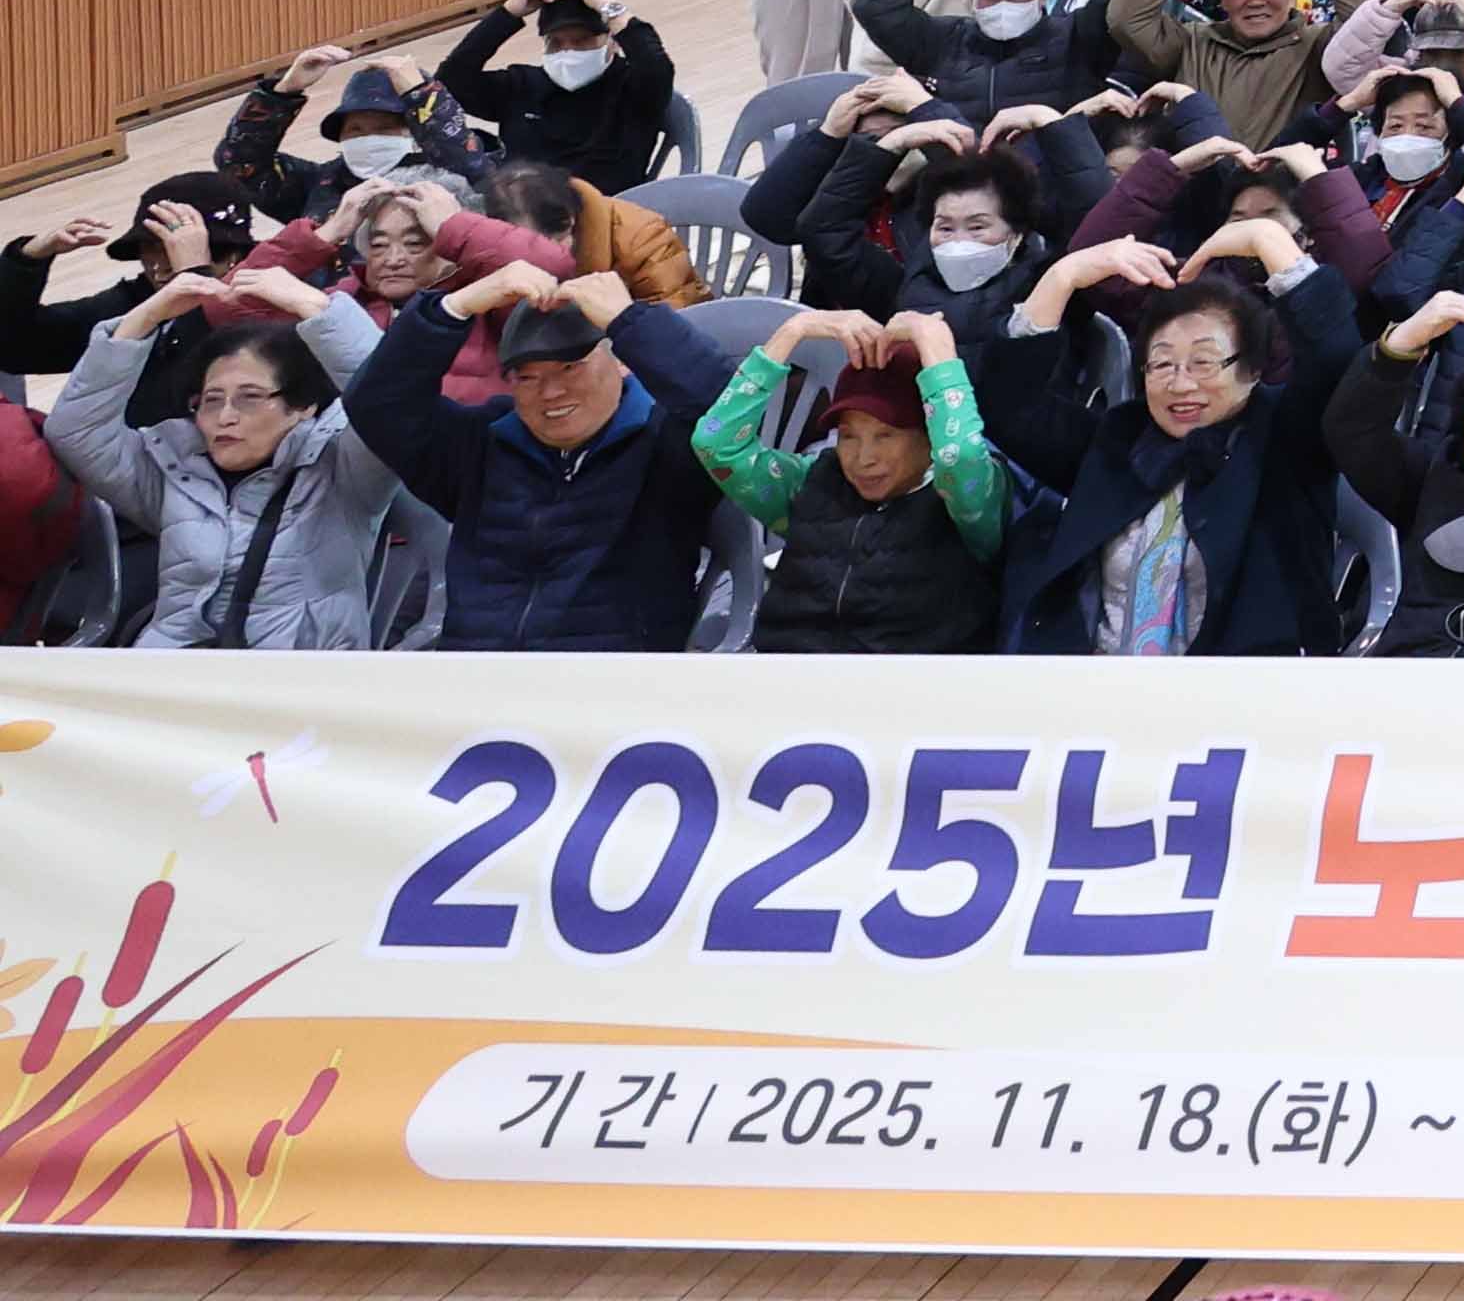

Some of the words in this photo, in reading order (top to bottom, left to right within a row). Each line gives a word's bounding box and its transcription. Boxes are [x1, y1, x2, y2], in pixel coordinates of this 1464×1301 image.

[378, 739, 1247, 960] 2025년
[728, 1078, 938, 1151] 2025.
[991, 1082, 1084, 1154] 11.
[1137, 1079, 1378, 1167] 18.(화)
